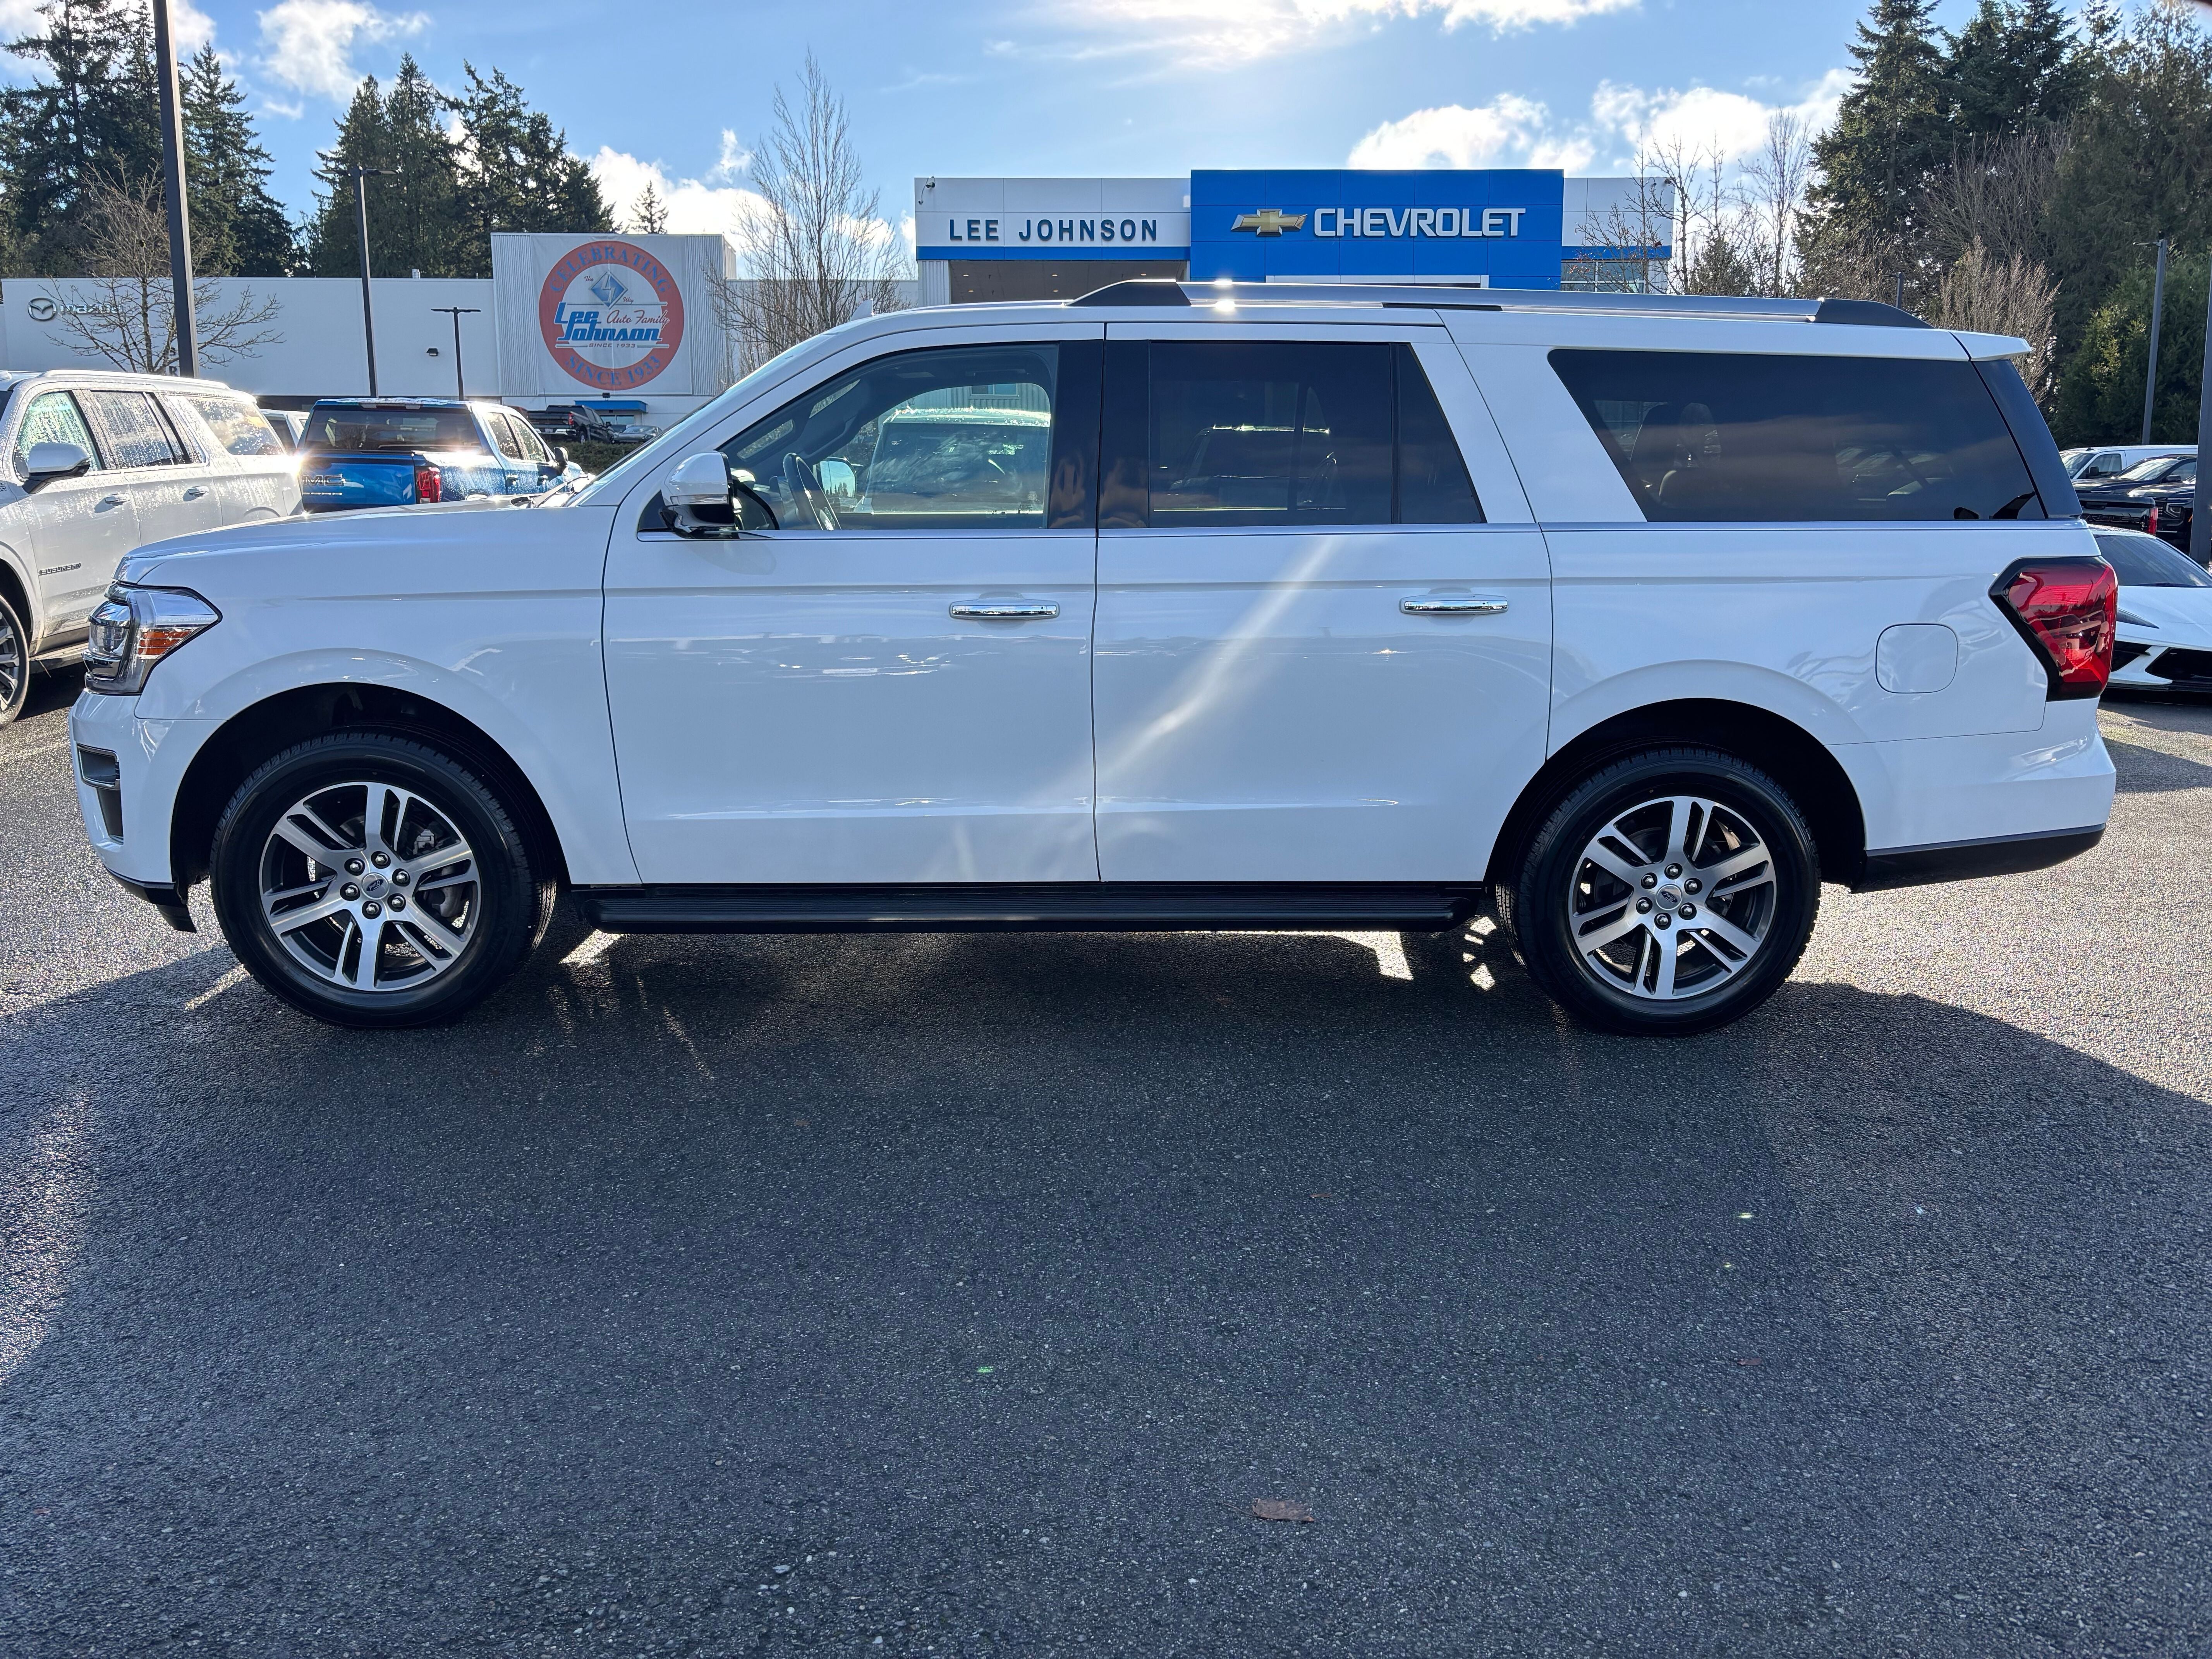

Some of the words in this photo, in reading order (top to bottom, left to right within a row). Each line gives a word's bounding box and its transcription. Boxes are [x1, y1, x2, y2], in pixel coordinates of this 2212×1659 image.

[950, 219, 999, 241] LEE
[1018, 219, 1157, 241] JOHNSON
[1314, 208, 1526, 236] CHEVROLET
[550, 246, 671, 292] CELEBRATING
[623, 297, 634, 305] Way
[554, 302, 601, 324] Lee
[606, 309, 632, 324] Auto
[634, 309, 670, 330] Family
[557, 321, 662, 341] Johnson
[565, 355, 622, 385] SINCE
[627, 355, 660, 383] 1933
[302, 473, 344, 488] MC
